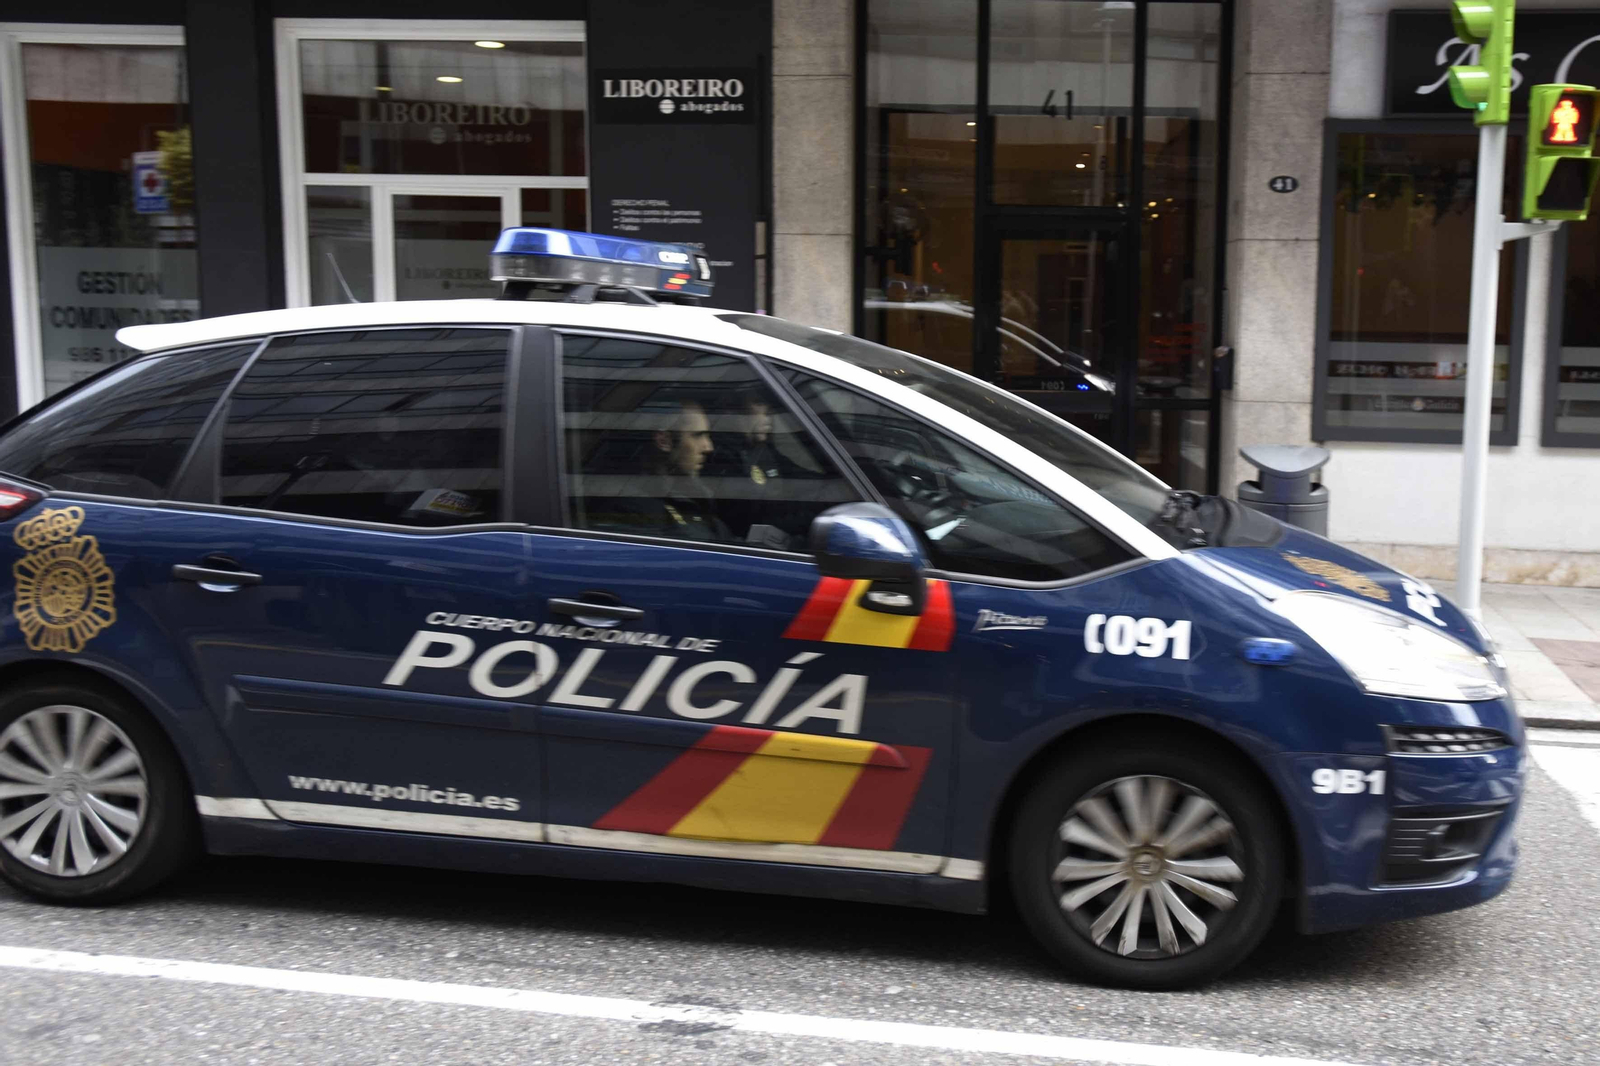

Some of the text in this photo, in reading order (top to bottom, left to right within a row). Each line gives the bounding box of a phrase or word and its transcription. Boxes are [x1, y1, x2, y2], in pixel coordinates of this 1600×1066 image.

[603, 78, 744, 98] LIBOREIRO
[359, 101, 531, 126] LIBOREIRO
[679, 101, 744, 115] abogados
[1041, 89, 1074, 121] 41
[451, 130, 532, 145] abogados
[1272, 178, 1293, 191] 41
[425, 611, 722, 653] CUERPO NACIONAL DE
[381, 629, 868, 735] POLICÍA
[288, 775, 521, 811] www.policia.es
[1311, 768, 1386, 795] 9B1
